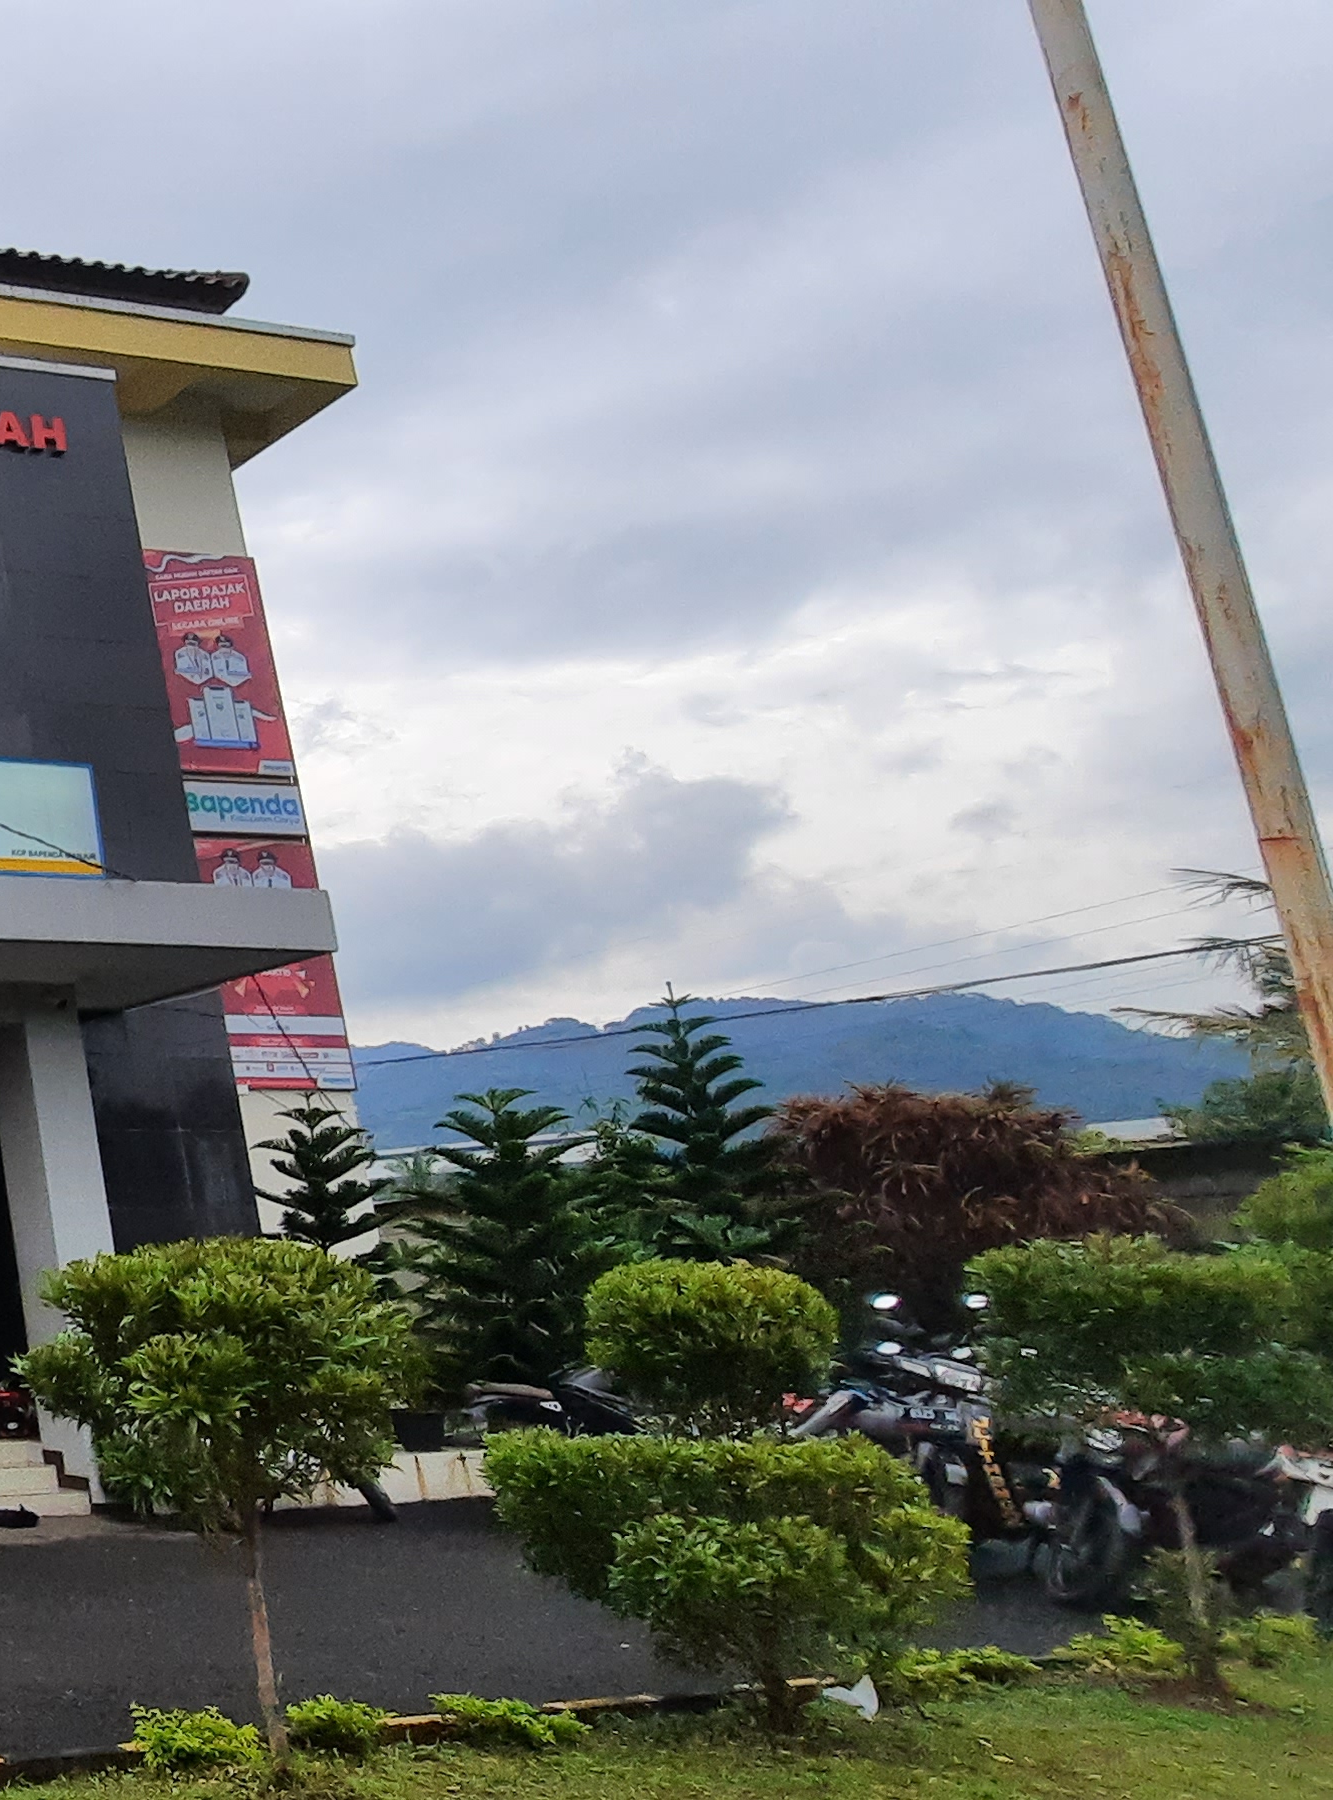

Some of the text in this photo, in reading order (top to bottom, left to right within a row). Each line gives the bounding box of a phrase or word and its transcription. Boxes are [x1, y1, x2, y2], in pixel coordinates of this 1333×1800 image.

[154, 583, 246, 602] LAPOR PAJAK
[174, 597, 230, 614] DAERAH
[185, 791, 299, 823] Bapenda
[28, 850, 63, 858] BAPENDA
